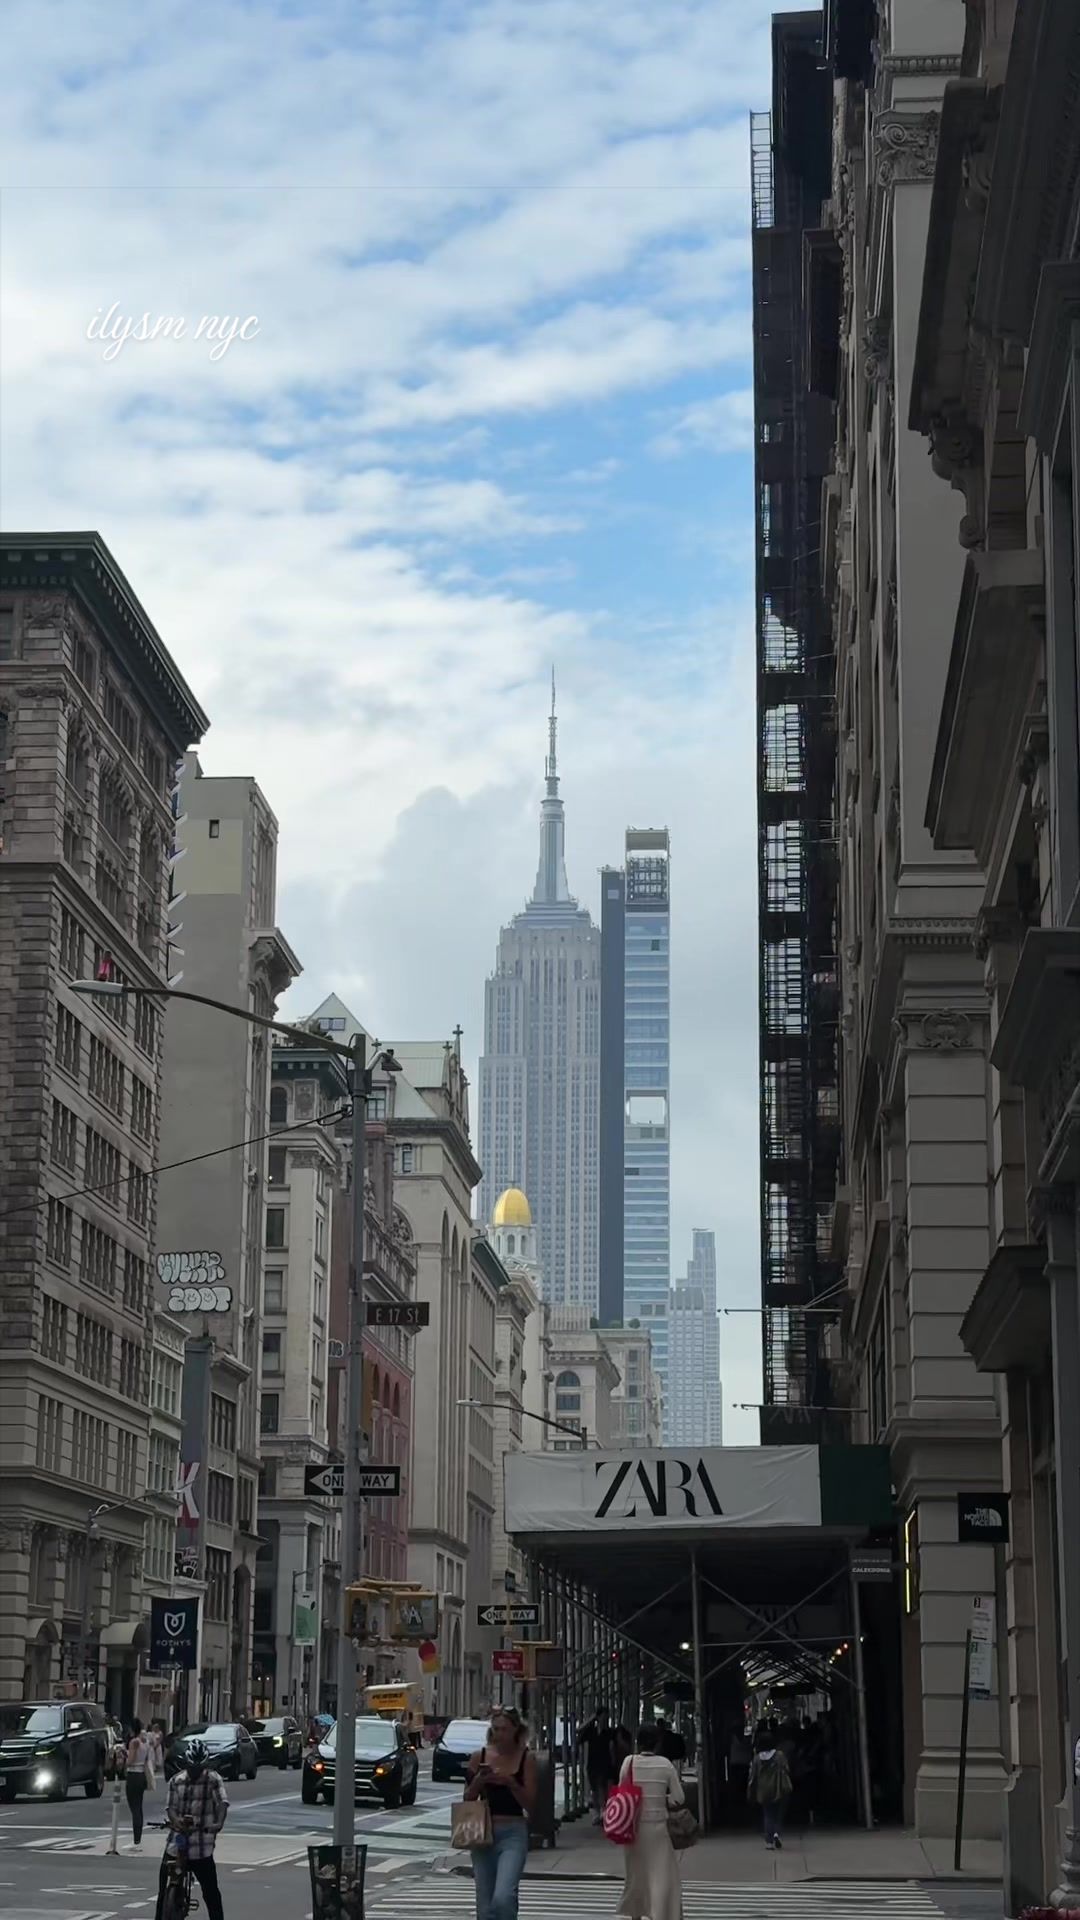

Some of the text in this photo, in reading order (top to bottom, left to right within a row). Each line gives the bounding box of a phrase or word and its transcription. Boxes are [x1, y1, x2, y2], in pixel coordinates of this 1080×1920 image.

[376, 1308, 383, 1323] E
[389, 1308, 400, 1323] 17
[322, 1474, 390, 1487] ON WAY
[594, 1458, 723, 1518] ZARA
[486, 1611, 531, 1620] ONE WAY
